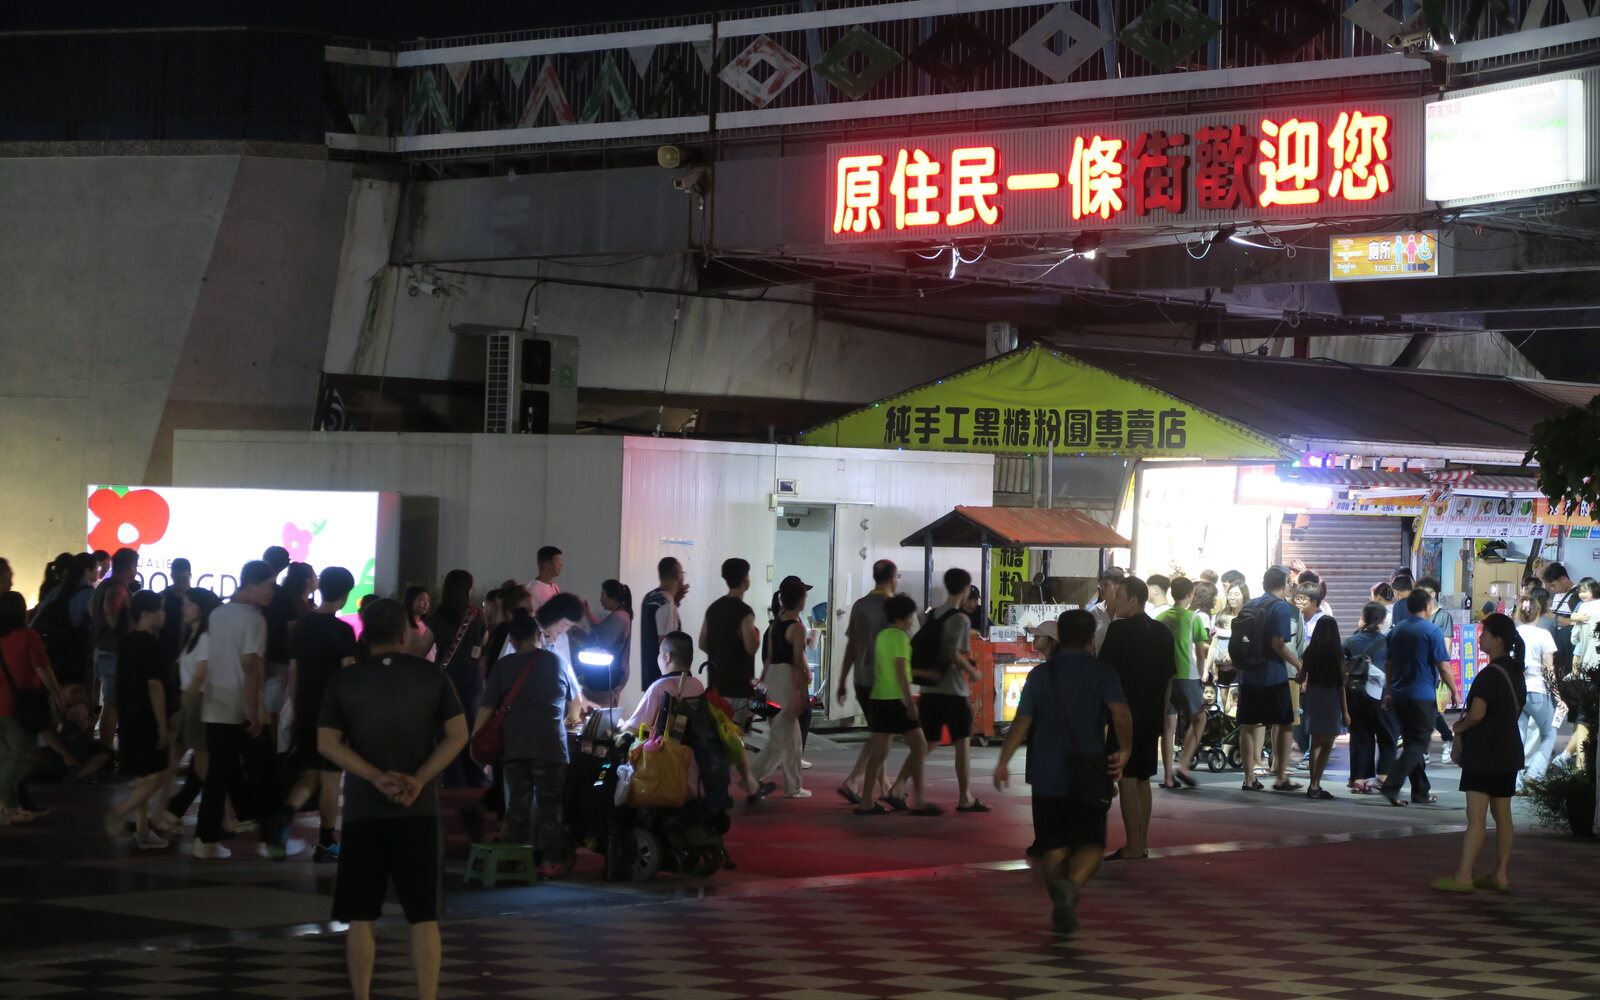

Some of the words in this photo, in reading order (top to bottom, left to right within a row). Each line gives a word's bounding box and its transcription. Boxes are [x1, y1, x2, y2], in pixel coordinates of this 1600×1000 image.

[832, 109, 1393, 235] 原住民一條街歡迎您
[1368, 240, 1391, 261] 廁所
[1374, 264, 1400, 272] TOILET
[884, 405, 1187, 449] 純手工黑糖粉圓專賣店
